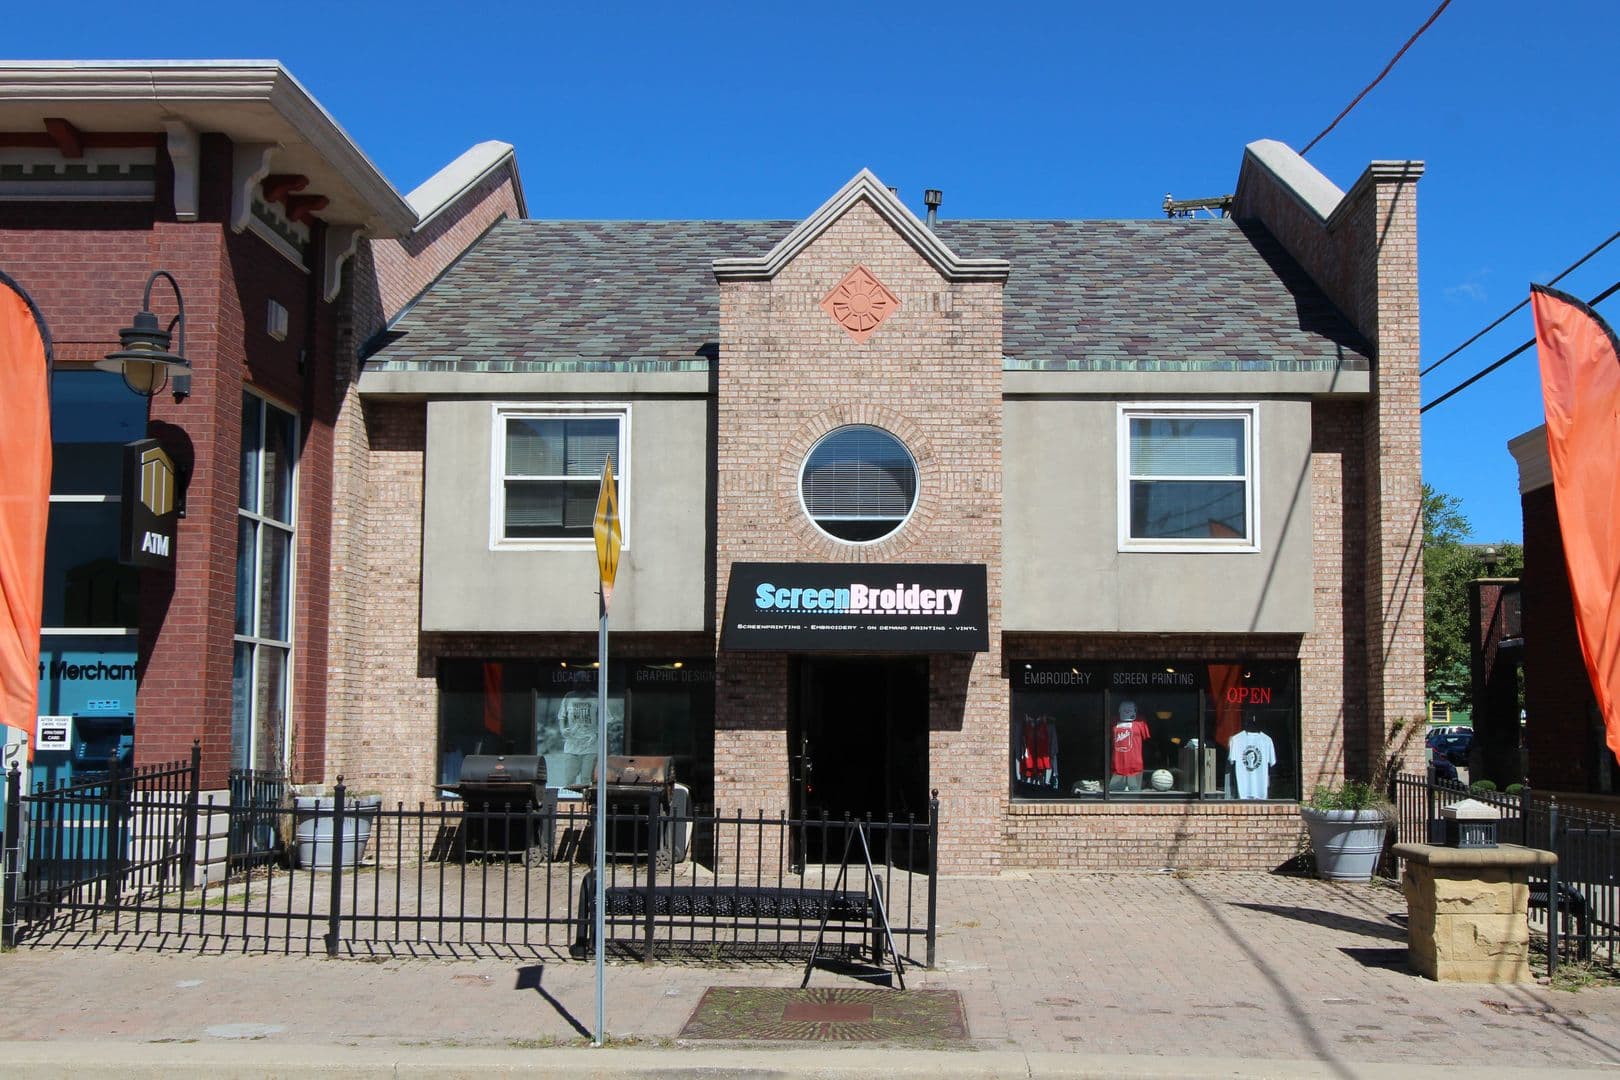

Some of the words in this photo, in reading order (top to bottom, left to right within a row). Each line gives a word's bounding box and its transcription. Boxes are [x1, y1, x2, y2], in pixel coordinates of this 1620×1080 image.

[142, 531, 169, 557] ATM
[755, 583, 963, 615] ScreenBroidery
[552, 671, 577, 683] LOCAL
[636, 670, 677, 681] GRAPHIC
[1024, 672, 1091, 685] EMBROIDERY
[1113, 672, 1148, 685] SCREEN
[1151, 672, 1194, 685] PRINTING
[1227, 687, 1271, 704] OPEN
